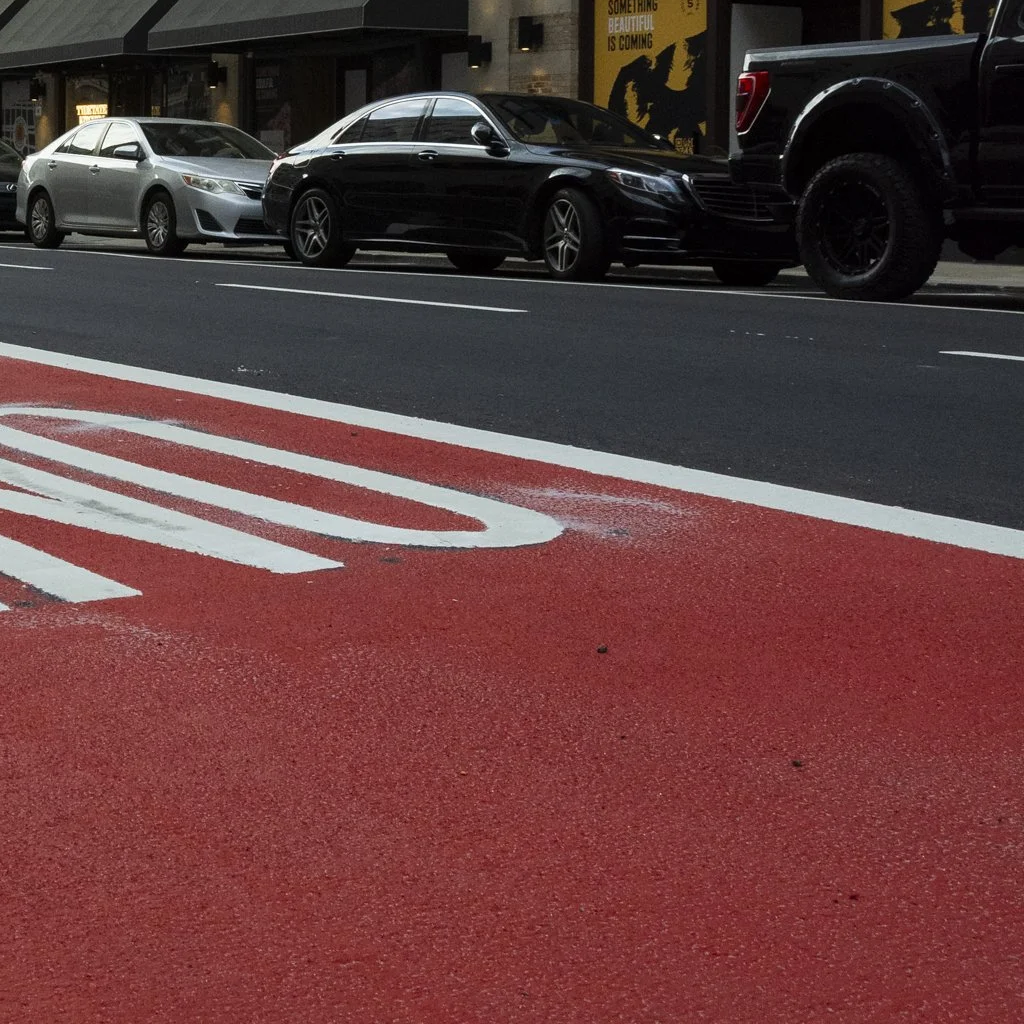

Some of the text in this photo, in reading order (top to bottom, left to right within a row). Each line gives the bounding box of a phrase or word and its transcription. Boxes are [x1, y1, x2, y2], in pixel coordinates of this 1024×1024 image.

[608, 14, 655, 33] BEAUTIFUL
[608, 32, 653, 51] IS COMING
